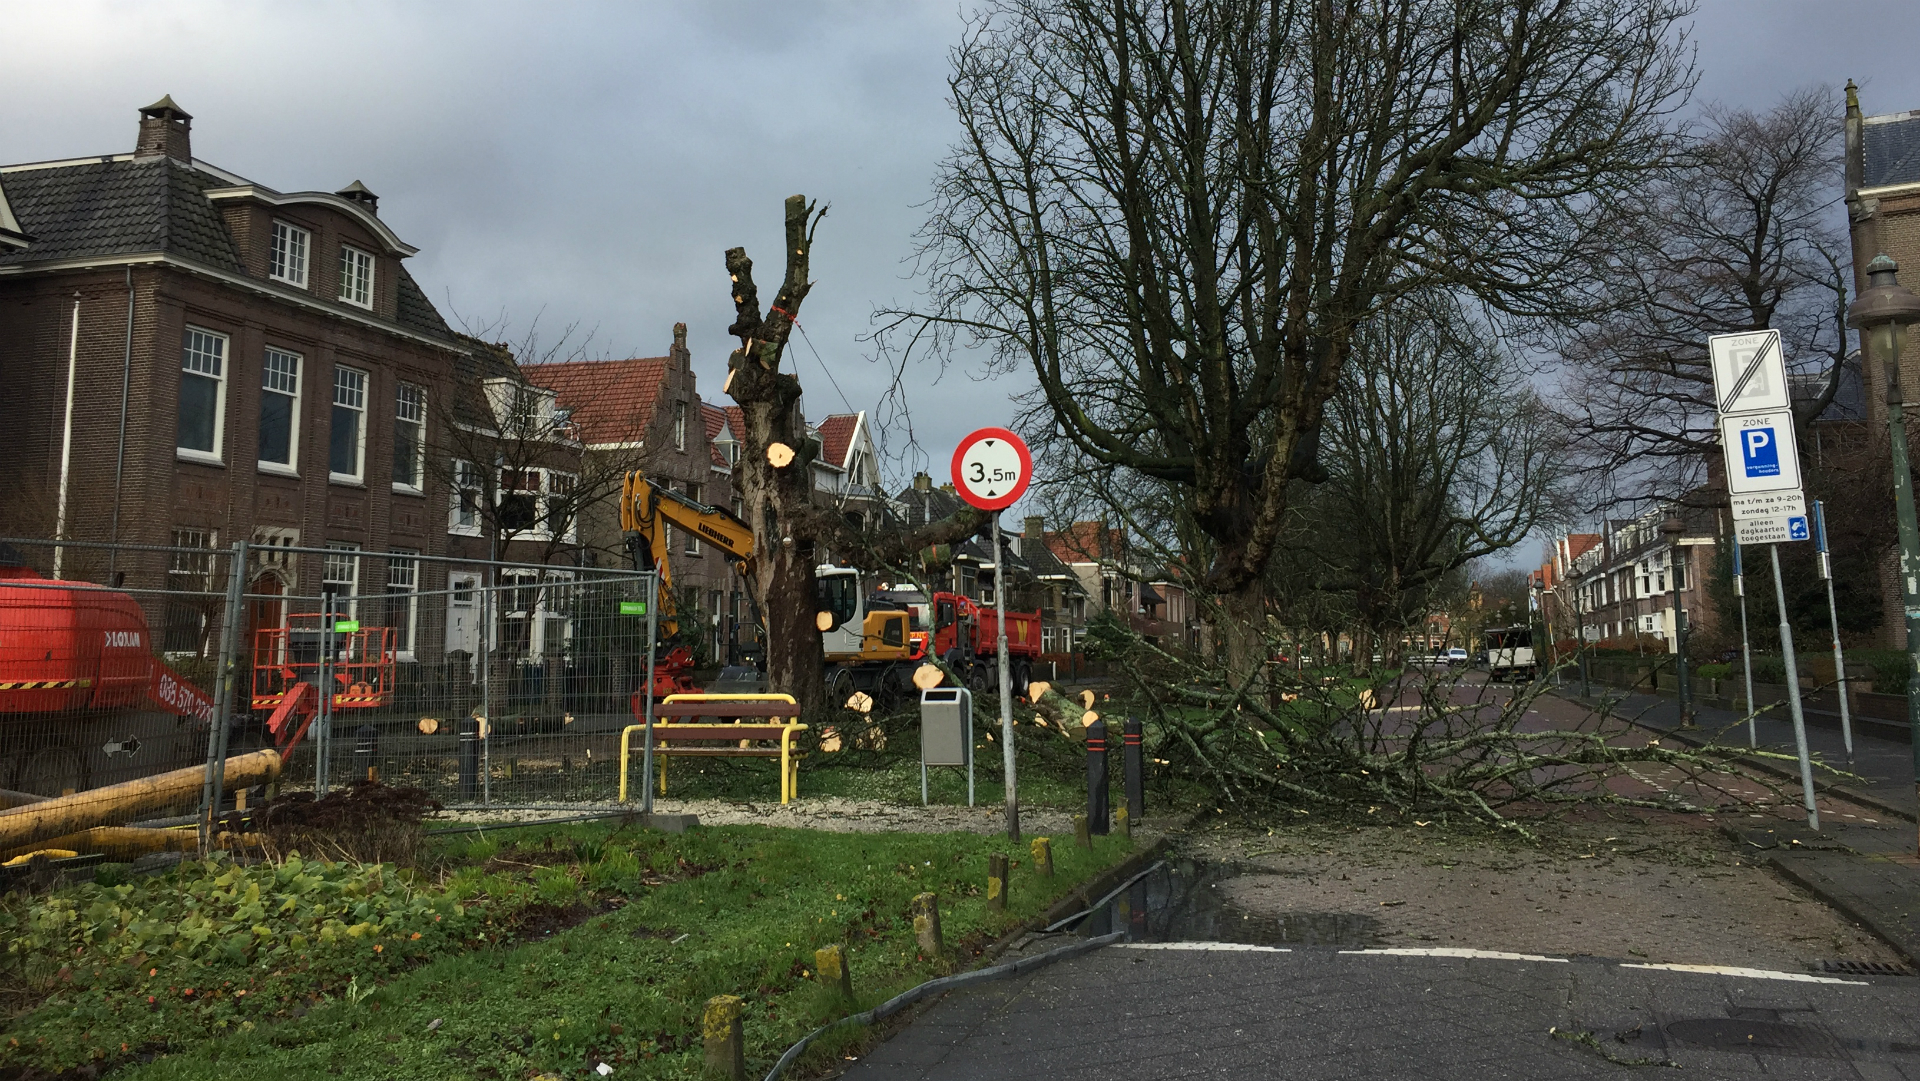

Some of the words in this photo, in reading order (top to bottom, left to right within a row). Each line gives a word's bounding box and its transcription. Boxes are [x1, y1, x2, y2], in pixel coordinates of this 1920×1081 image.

[1731, 337, 1759, 346] ZONE
[1743, 418, 1770, 427] ZONE
[1747, 431, 1769, 458] P
[969, 462, 1016, 484] 3,5m
[698, 522, 734, 548] LIEBHERR
[1740, 526, 1785, 535] dagkaarten
[1741, 534, 1786, 542] toegestaan
[177, 686, 194, 714] 570
